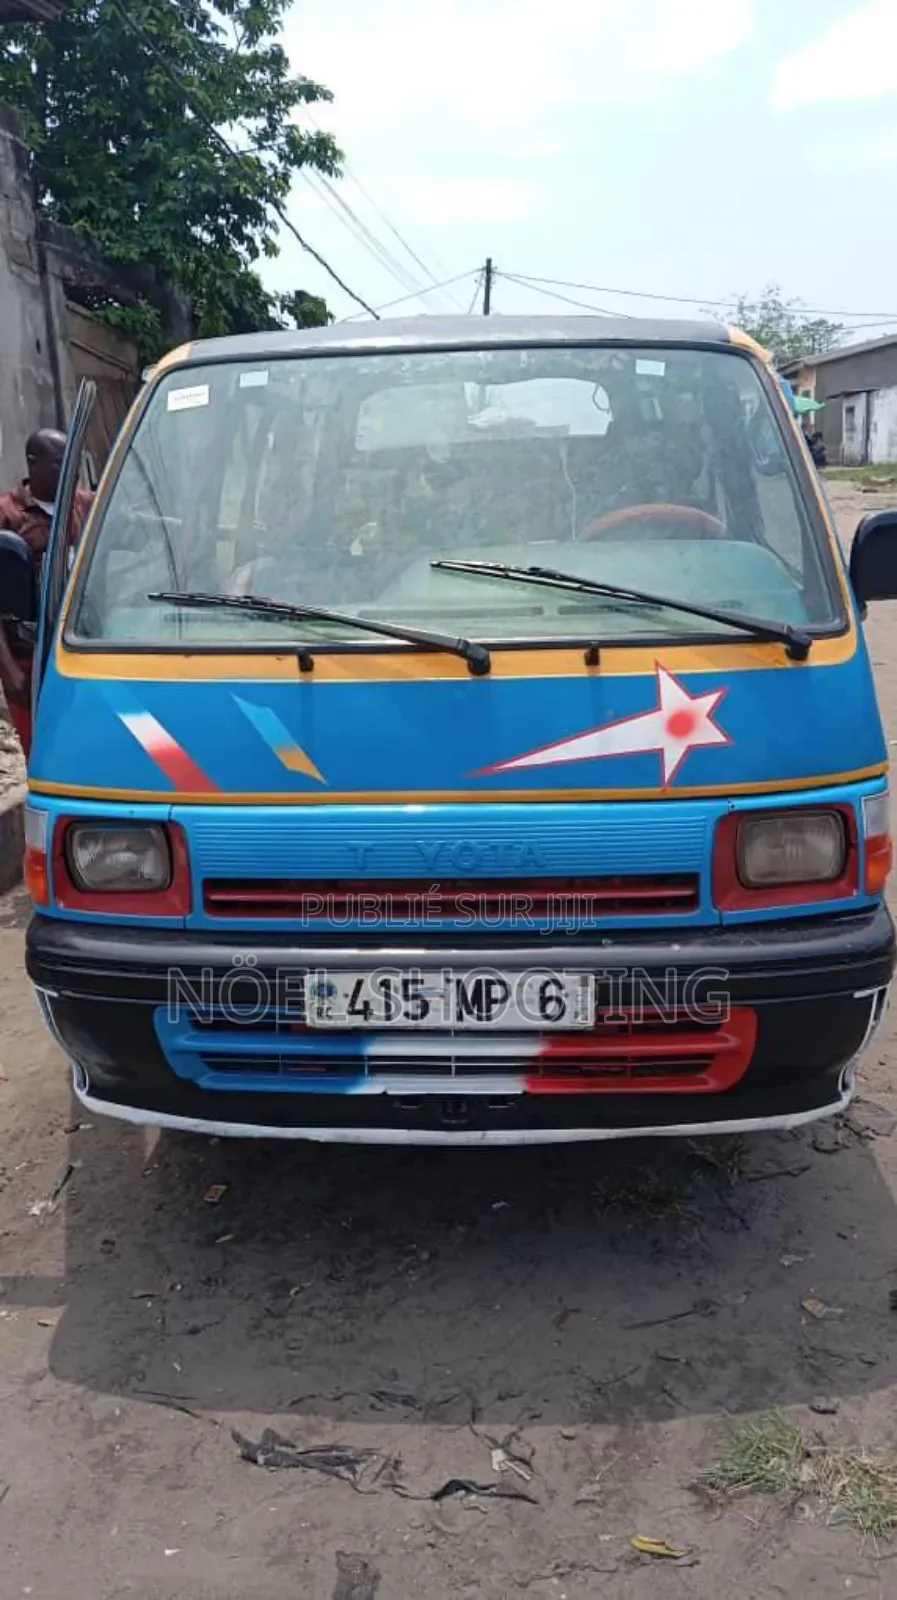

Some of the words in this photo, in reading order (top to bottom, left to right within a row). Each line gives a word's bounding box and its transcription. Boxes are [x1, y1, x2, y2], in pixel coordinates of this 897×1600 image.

[347, 978, 430, 1021] 415
[456, 978, 511, 1022] MP
[539, 978, 566, 1022] 6
